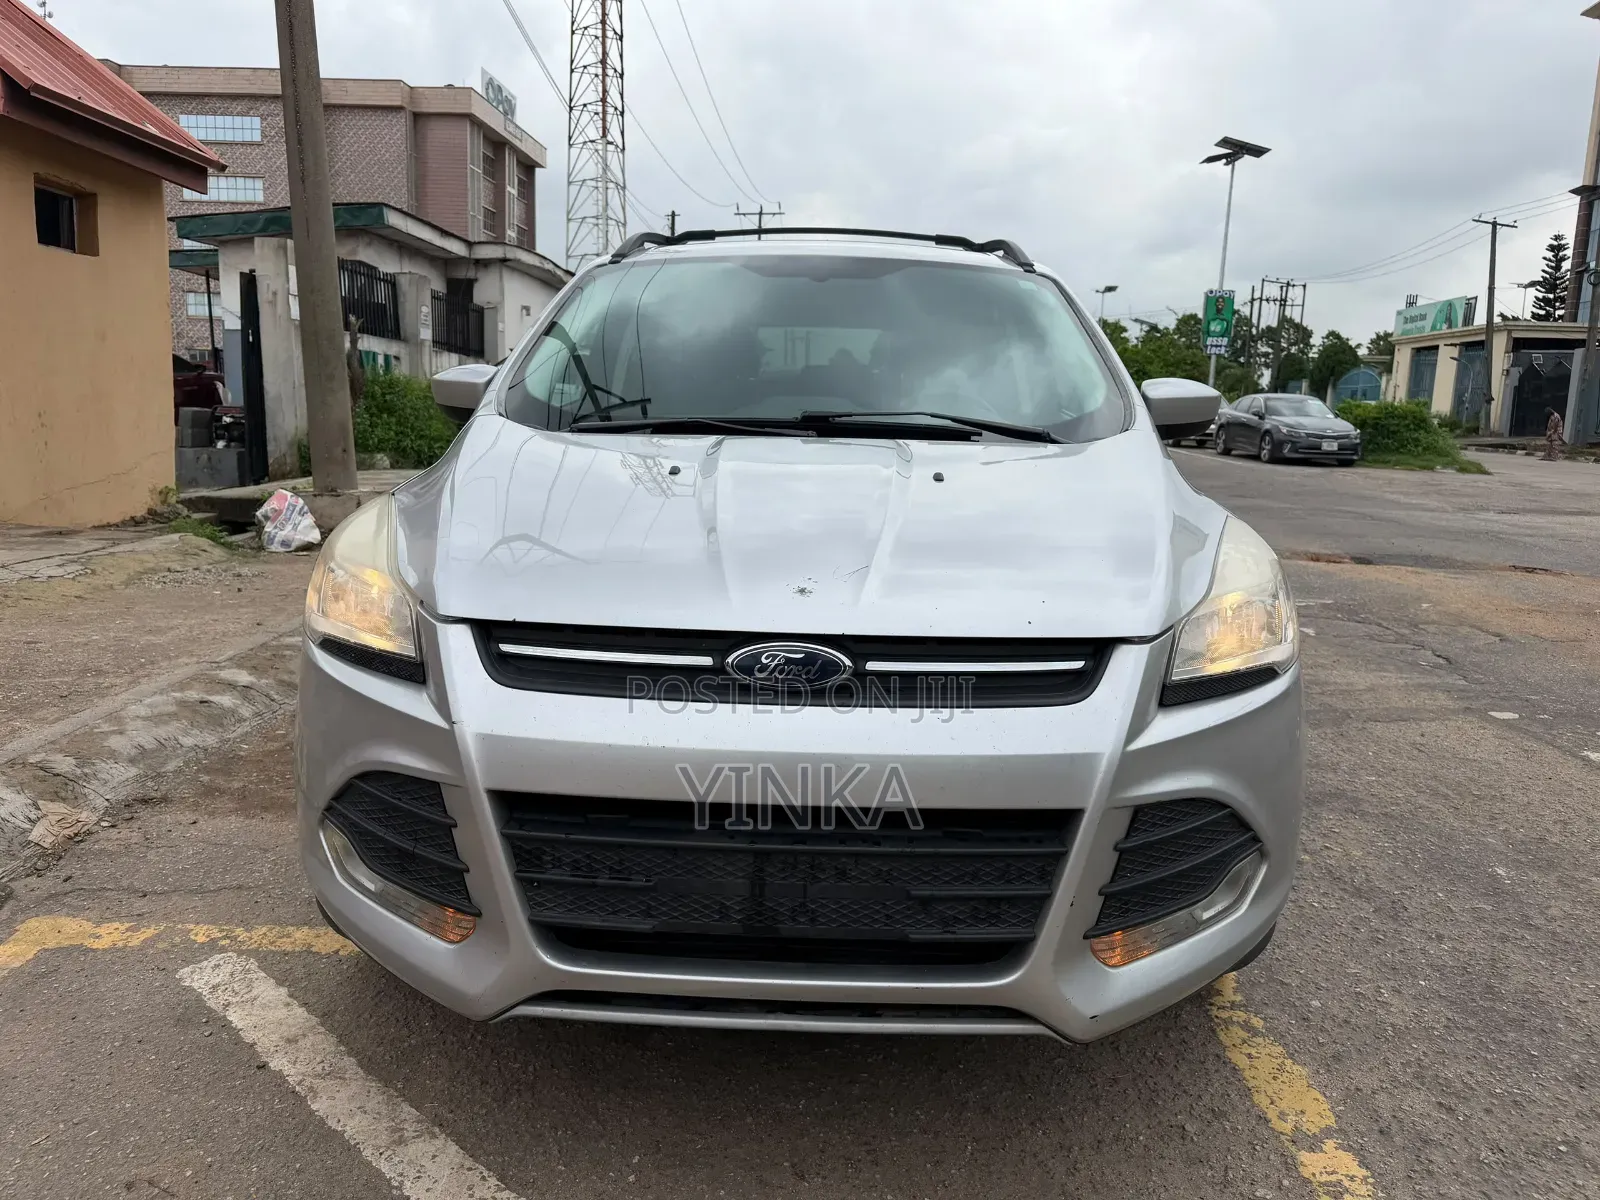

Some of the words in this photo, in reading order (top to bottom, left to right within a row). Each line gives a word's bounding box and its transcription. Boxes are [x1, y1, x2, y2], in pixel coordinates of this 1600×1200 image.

[1207, 289, 1235, 299] OPay
[1206, 337, 1229, 346] USSD
[1207, 346, 1226, 354] Lock
[754, 651, 823, 679] Ford
